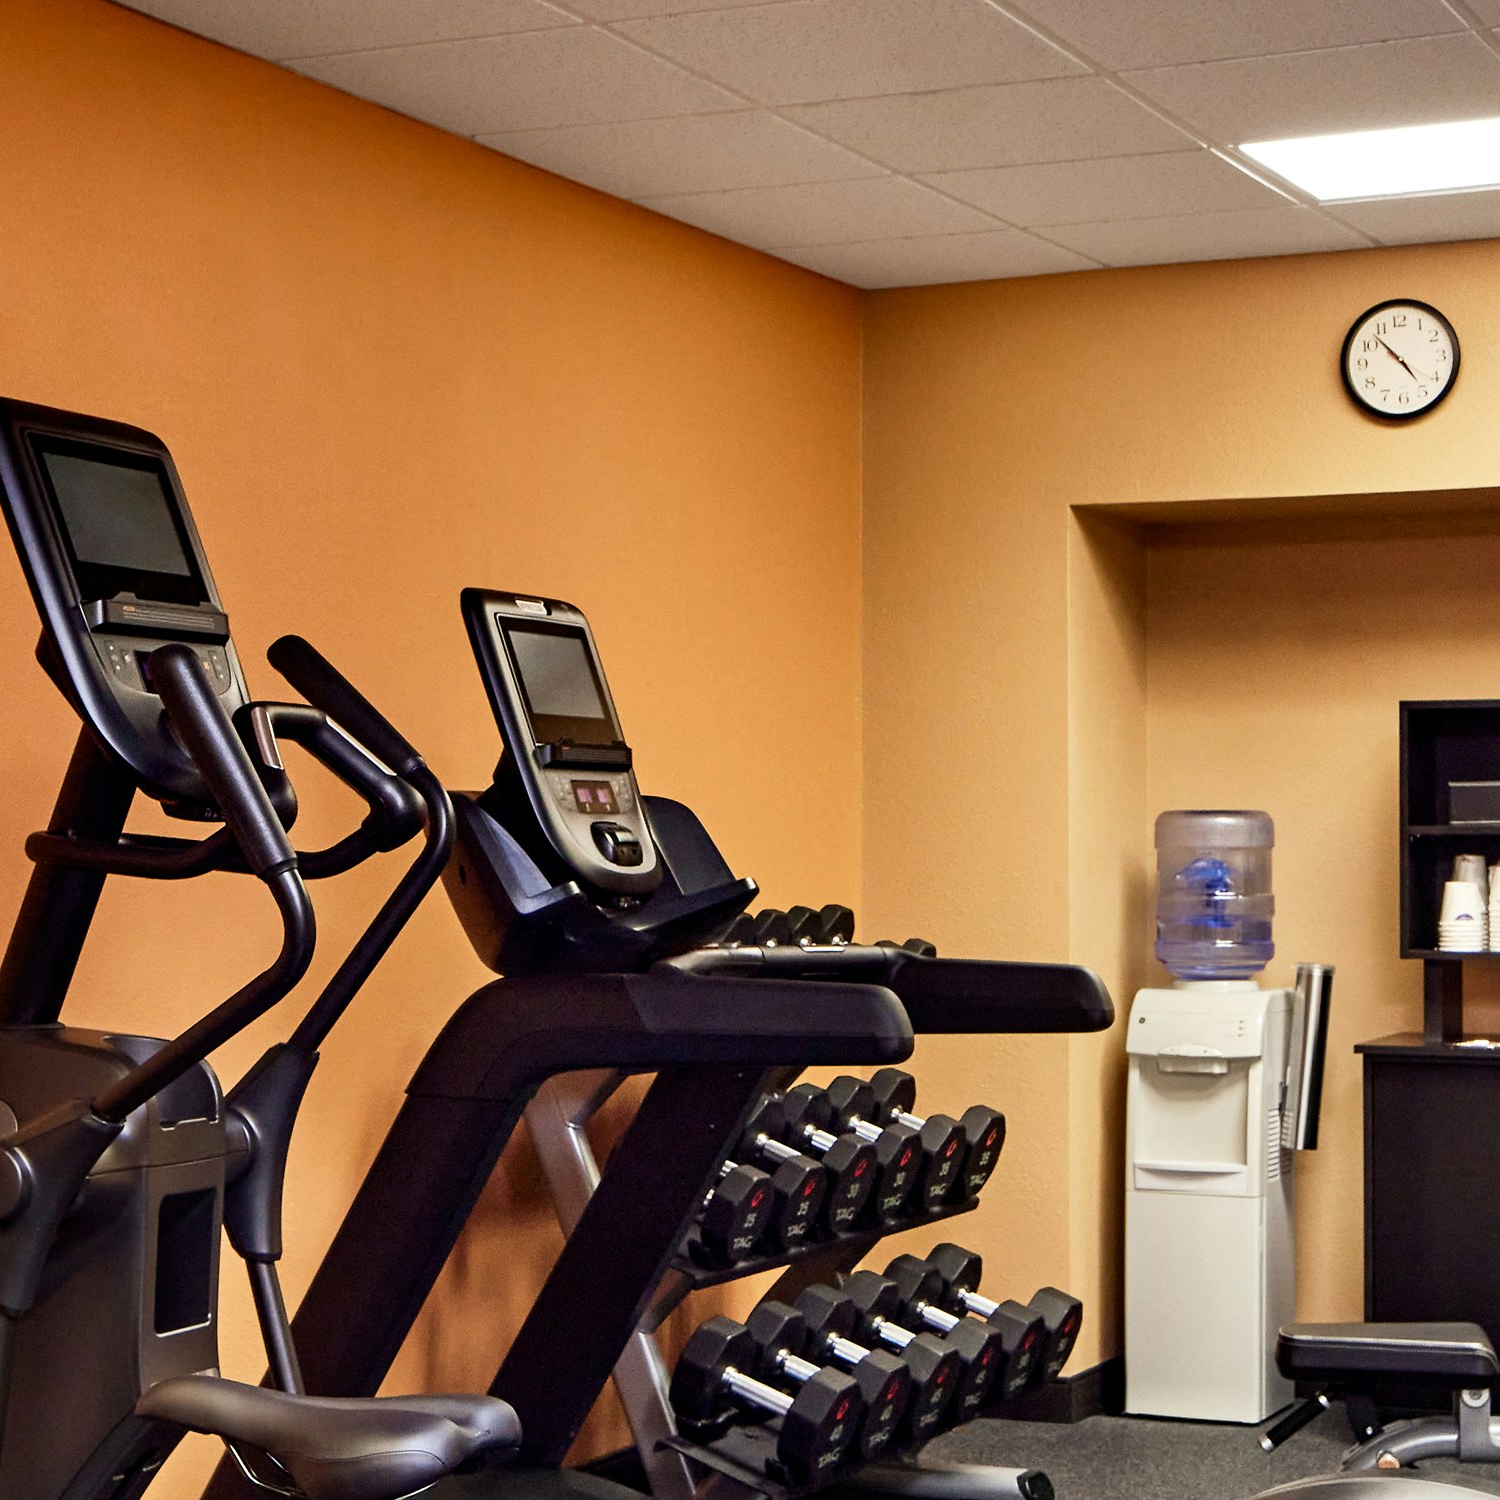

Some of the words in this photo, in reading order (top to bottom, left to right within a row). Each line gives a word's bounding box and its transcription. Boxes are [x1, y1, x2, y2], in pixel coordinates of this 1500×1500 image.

[1392, 315, 1407, 327] 12
[1376, 322, 1387, 335] 11
[1429, 329, 1439, 342] 2
[1362, 339, 1378, 352] 10
[1436, 350, 1447, 362] 3
[1357, 358, 1368, 371] 9
[1430, 370, 1441, 382] 4
[1364, 377, 1376, 389] 8
[1381, 389, 1390, 402] 7
[1417, 385, 1428, 398] 5
[1398, 392, 1409, 405] 6
